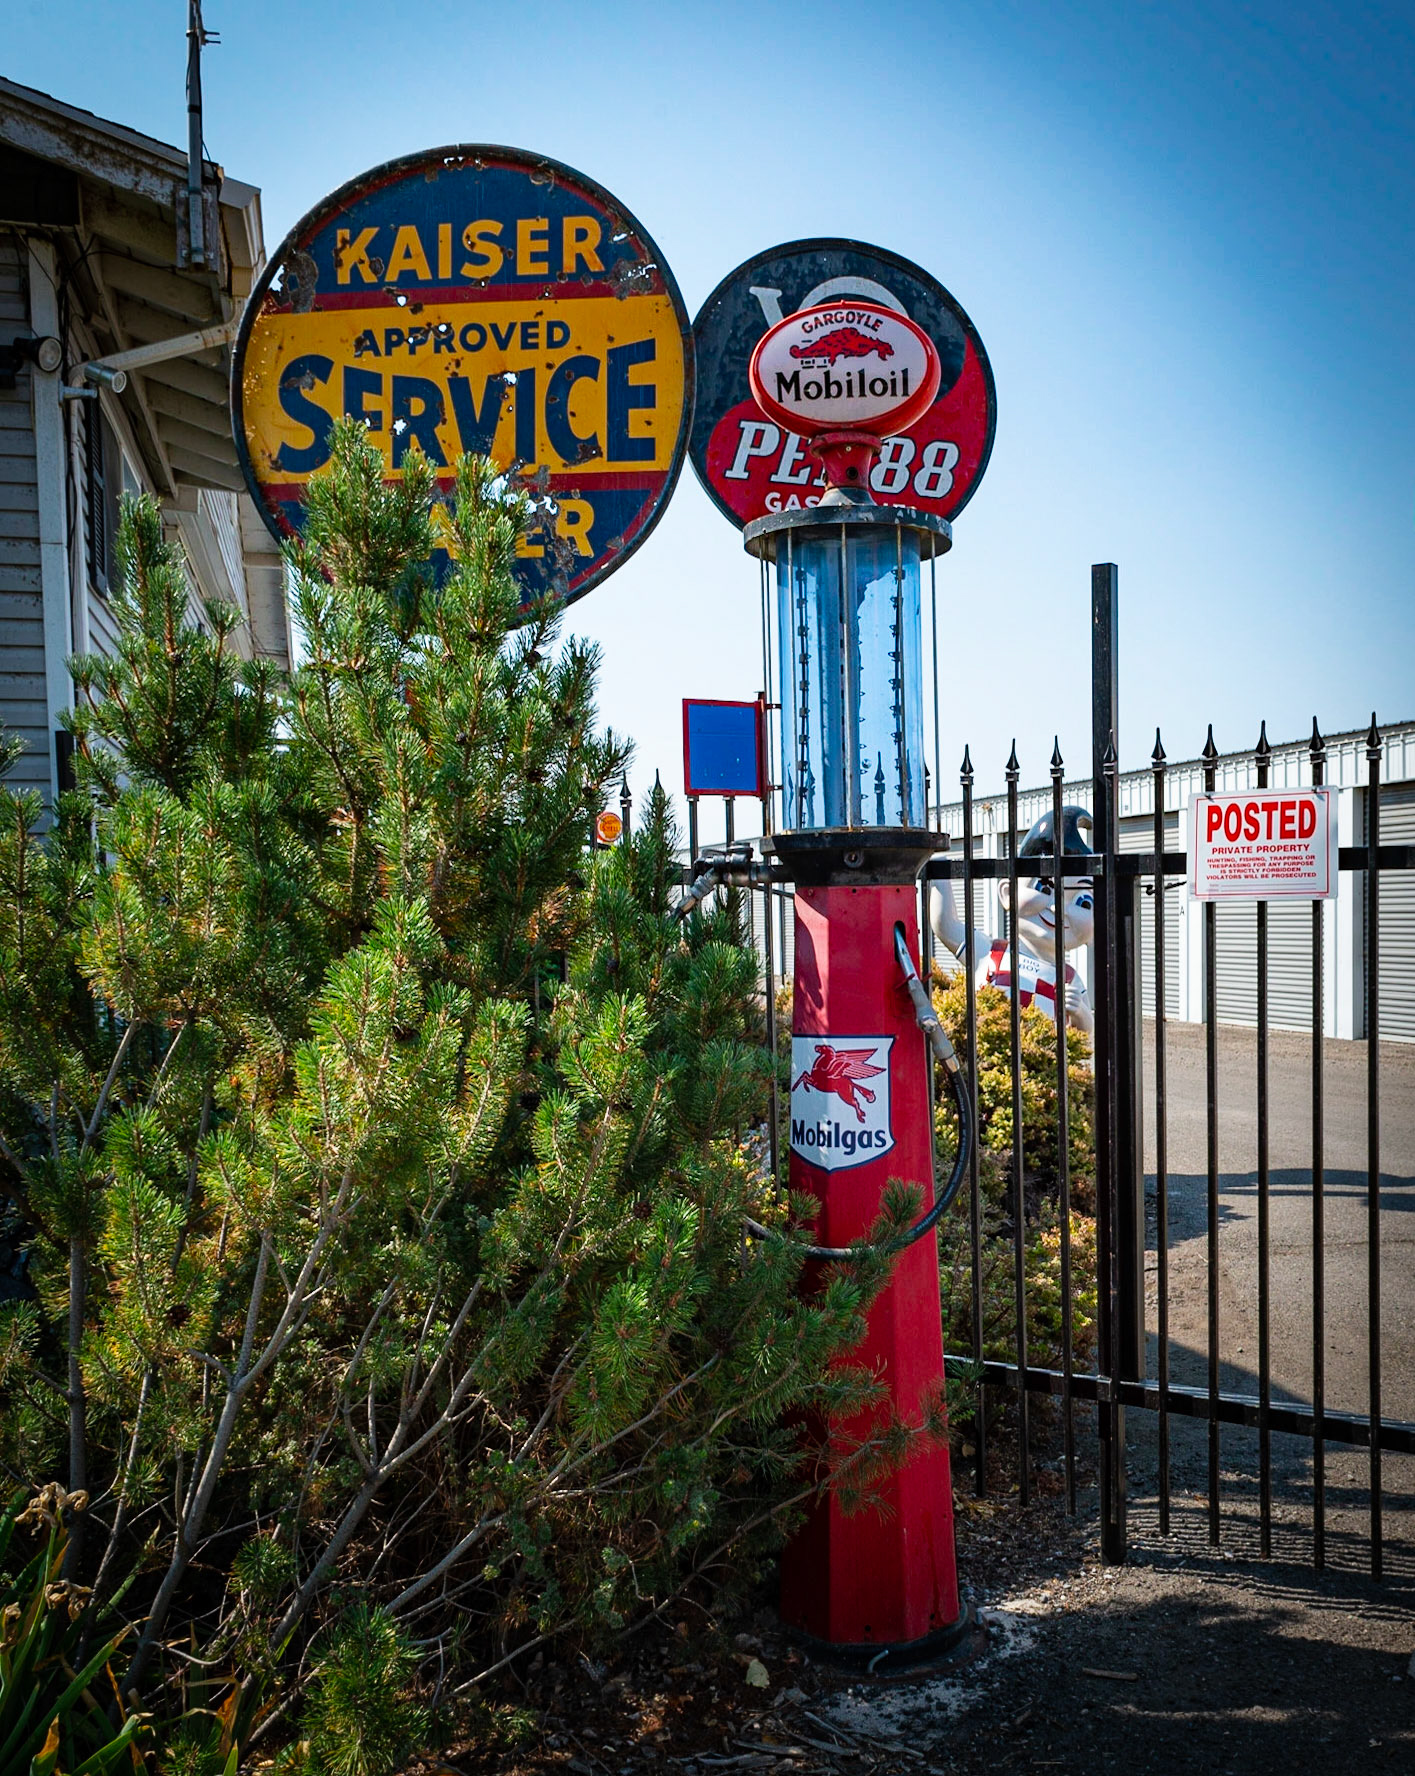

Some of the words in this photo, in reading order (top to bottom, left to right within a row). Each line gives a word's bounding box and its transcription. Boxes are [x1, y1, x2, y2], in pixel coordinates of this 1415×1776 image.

[336, 216, 605, 285] KAISER
[354, 320, 571, 358] APPROVED
[801, 310, 884, 333] GARGOYLE
[775, 367, 910, 403] Mobiloil
[278, 338, 657, 474] SERVICE
[724, 420, 832, 488] PE
[870, 436, 960, 499] 88
[1206, 799, 1317, 843] POSTED
[1212, 846, 1253, 855] PRIVATE
[1256, 844, 1310, 853] PROPERTY
[791, 1118, 888, 1156] Mobilgas
